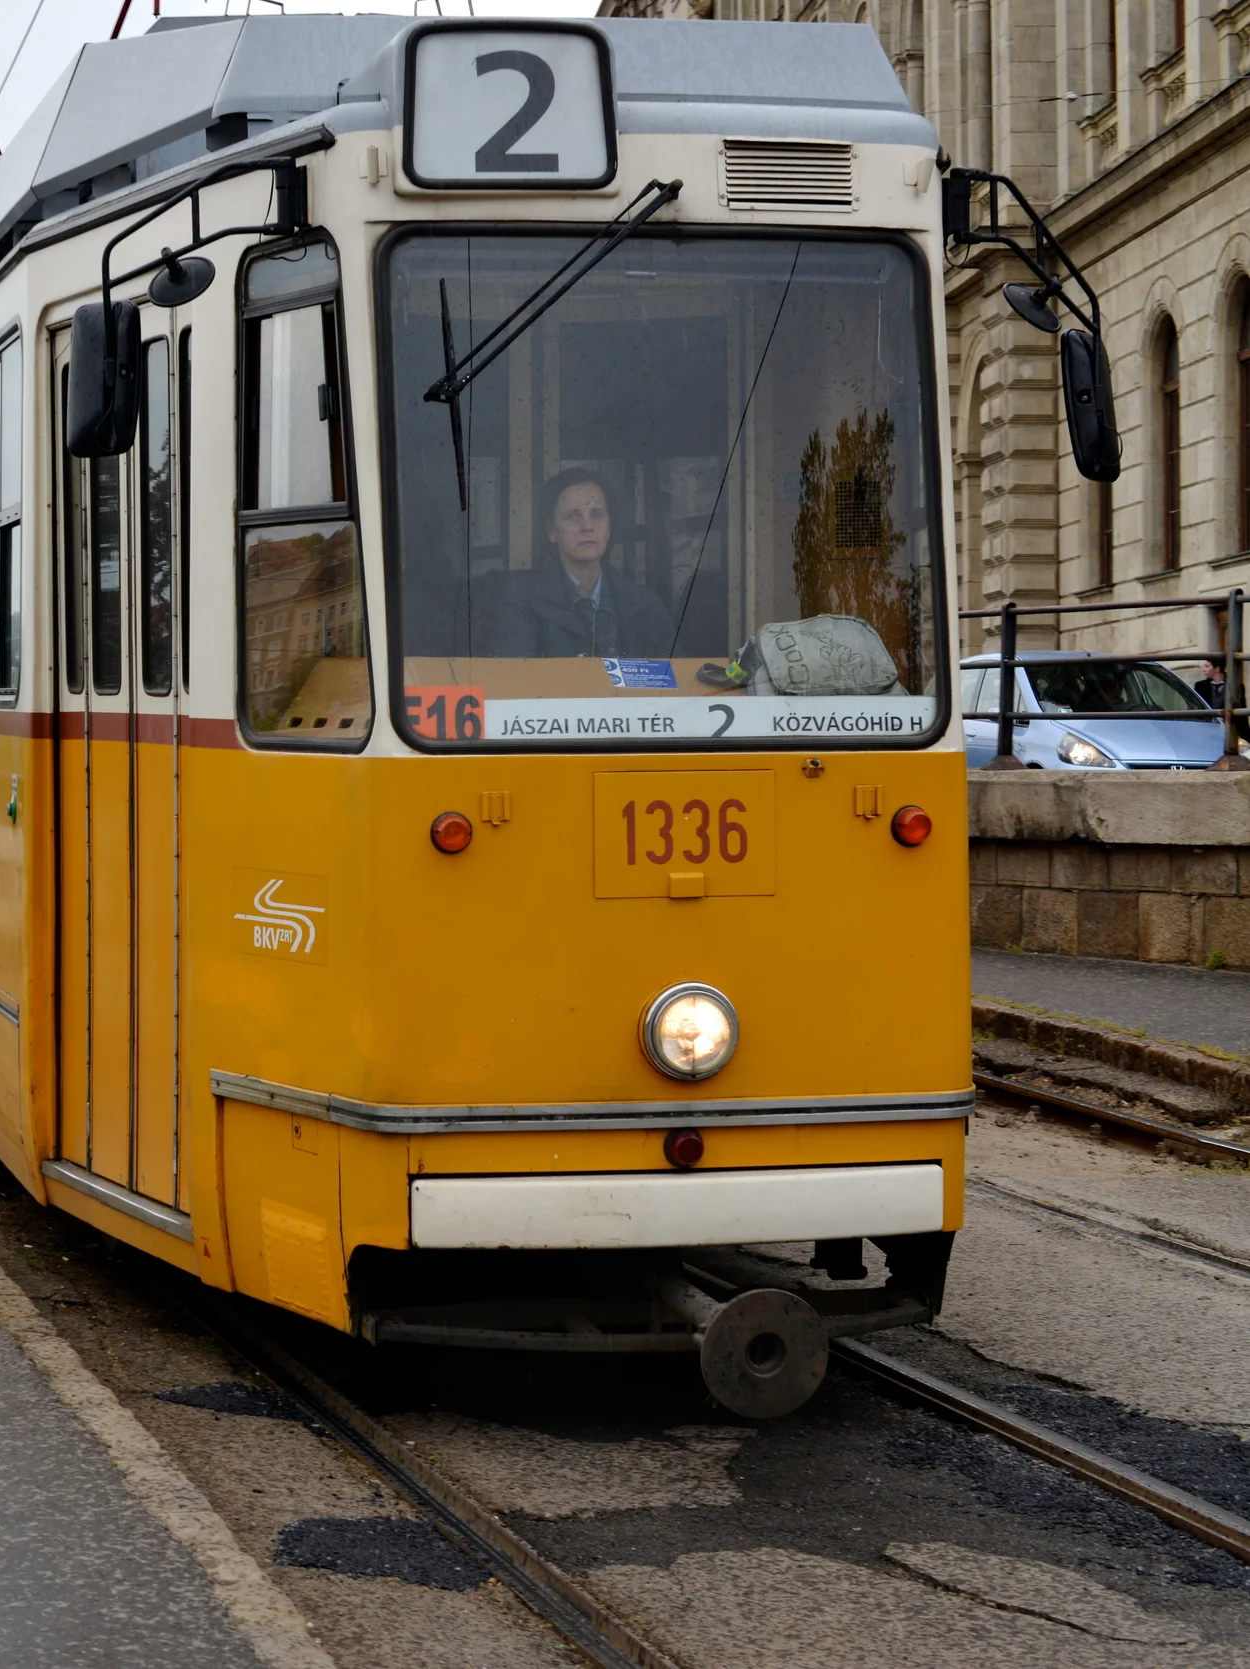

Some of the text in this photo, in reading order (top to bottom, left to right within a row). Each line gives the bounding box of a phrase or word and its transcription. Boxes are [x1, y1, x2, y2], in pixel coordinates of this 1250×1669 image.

[474, 50, 559, 173] 2
[501, 716, 569, 736] JÁSZAI
[577, 717, 631, 734] MARI
[637, 713, 675, 733] TÉR
[772, 712, 903, 732] KÖZVÁGÓHÍD
[911, 716, 923, 732] H
[622, 798, 748, 865] 1336
